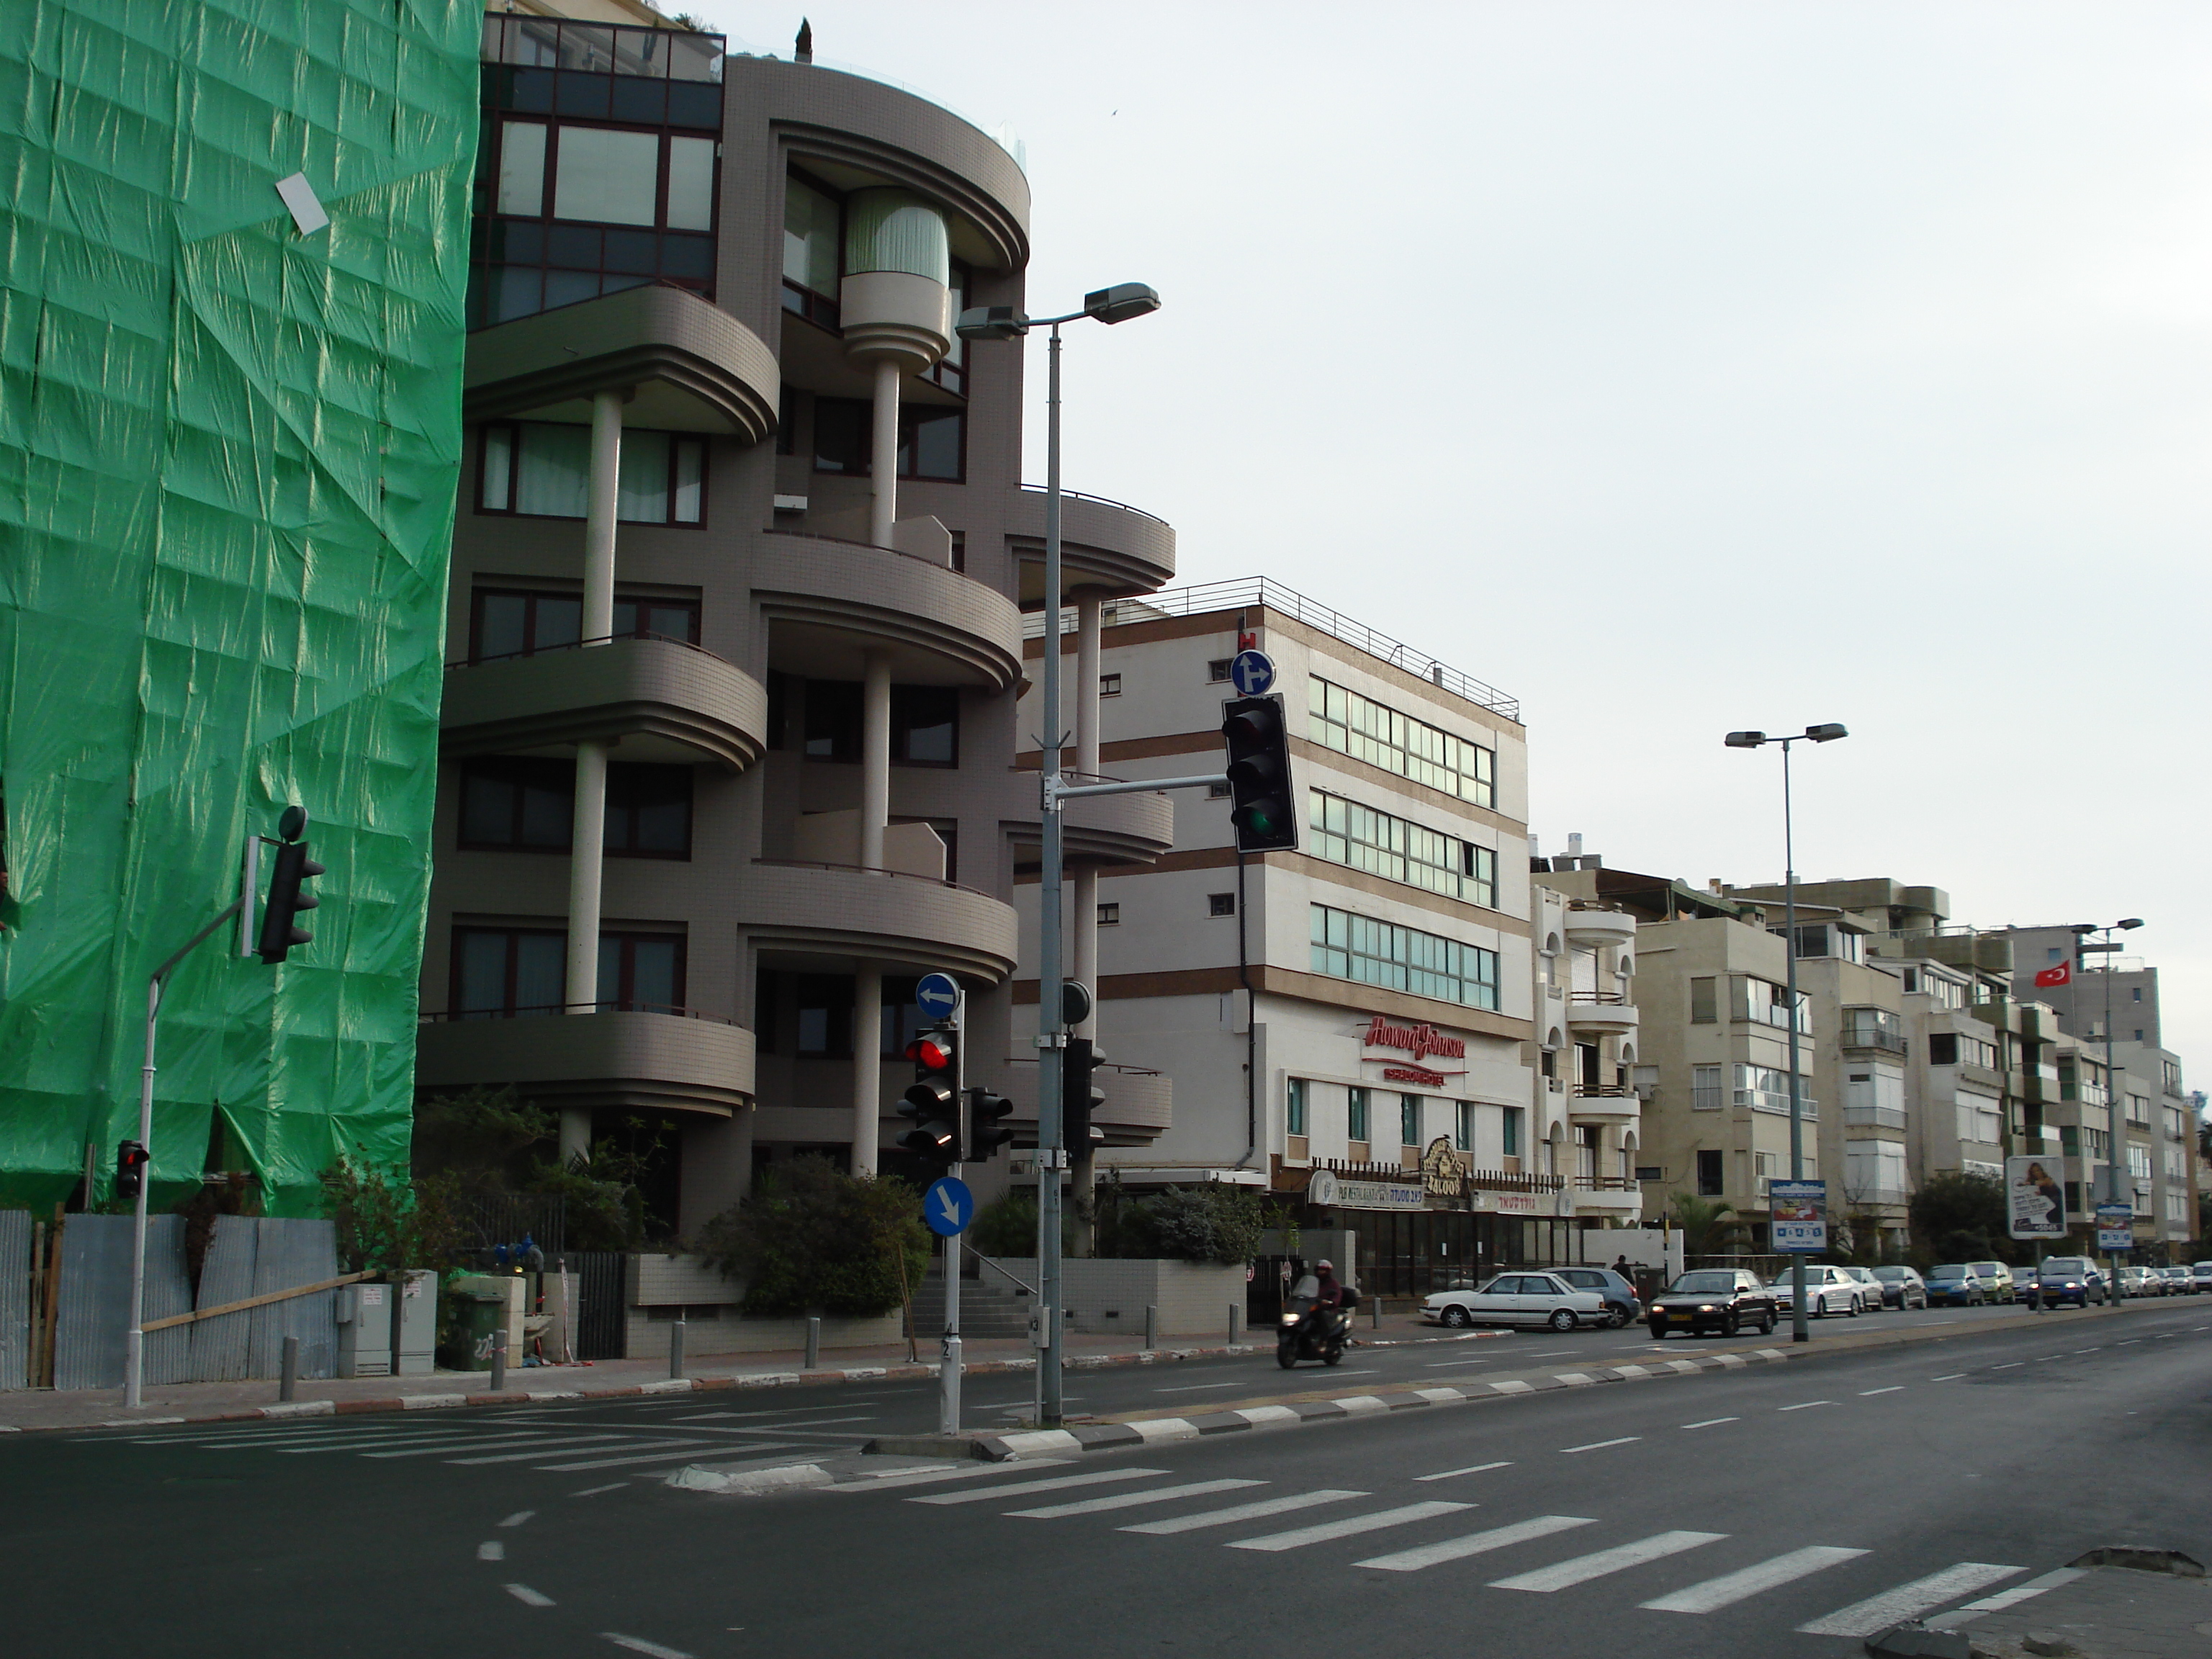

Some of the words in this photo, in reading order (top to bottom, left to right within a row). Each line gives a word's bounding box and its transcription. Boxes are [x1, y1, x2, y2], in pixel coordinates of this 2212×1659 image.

[1365, 1016, 1419, 1050] Howard
[1415, 1024, 1466, 1060] Johnson
[1385, 1069, 1421, 1082] SHALOM
[1422, 1072, 1447, 1086] HOTEL
[1428, 1175, 1460, 1195] SALOON
